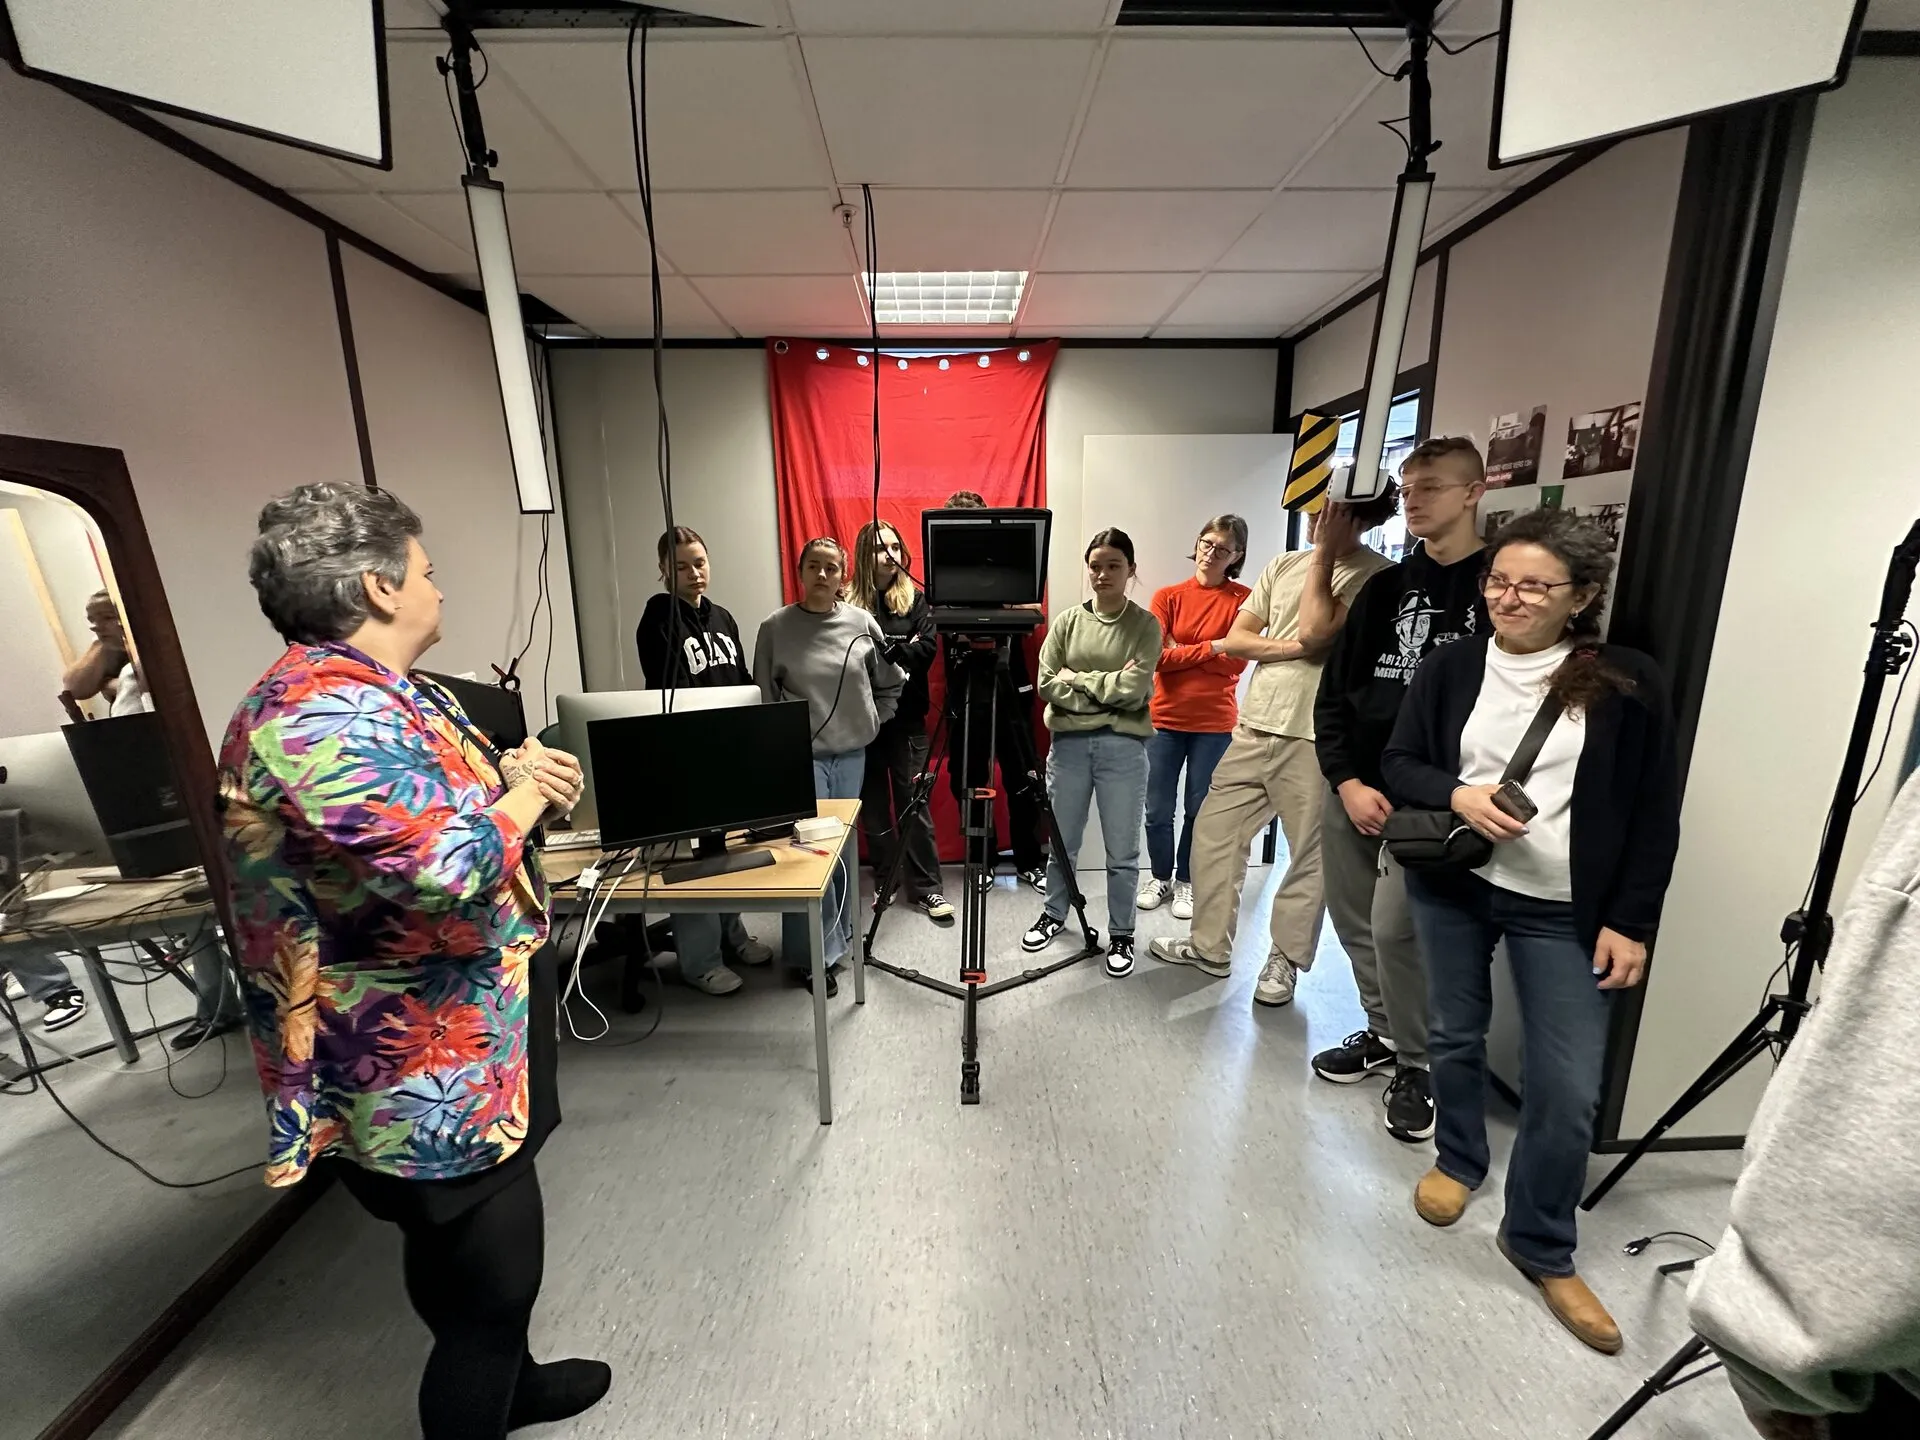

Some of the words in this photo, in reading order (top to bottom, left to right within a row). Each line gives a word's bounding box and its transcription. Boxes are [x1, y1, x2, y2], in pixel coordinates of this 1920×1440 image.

[683, 632, 737, 675] GAP
[1377, 653, 1395, 665] ABI
[1374, 666, 1402, 678] MEIST
